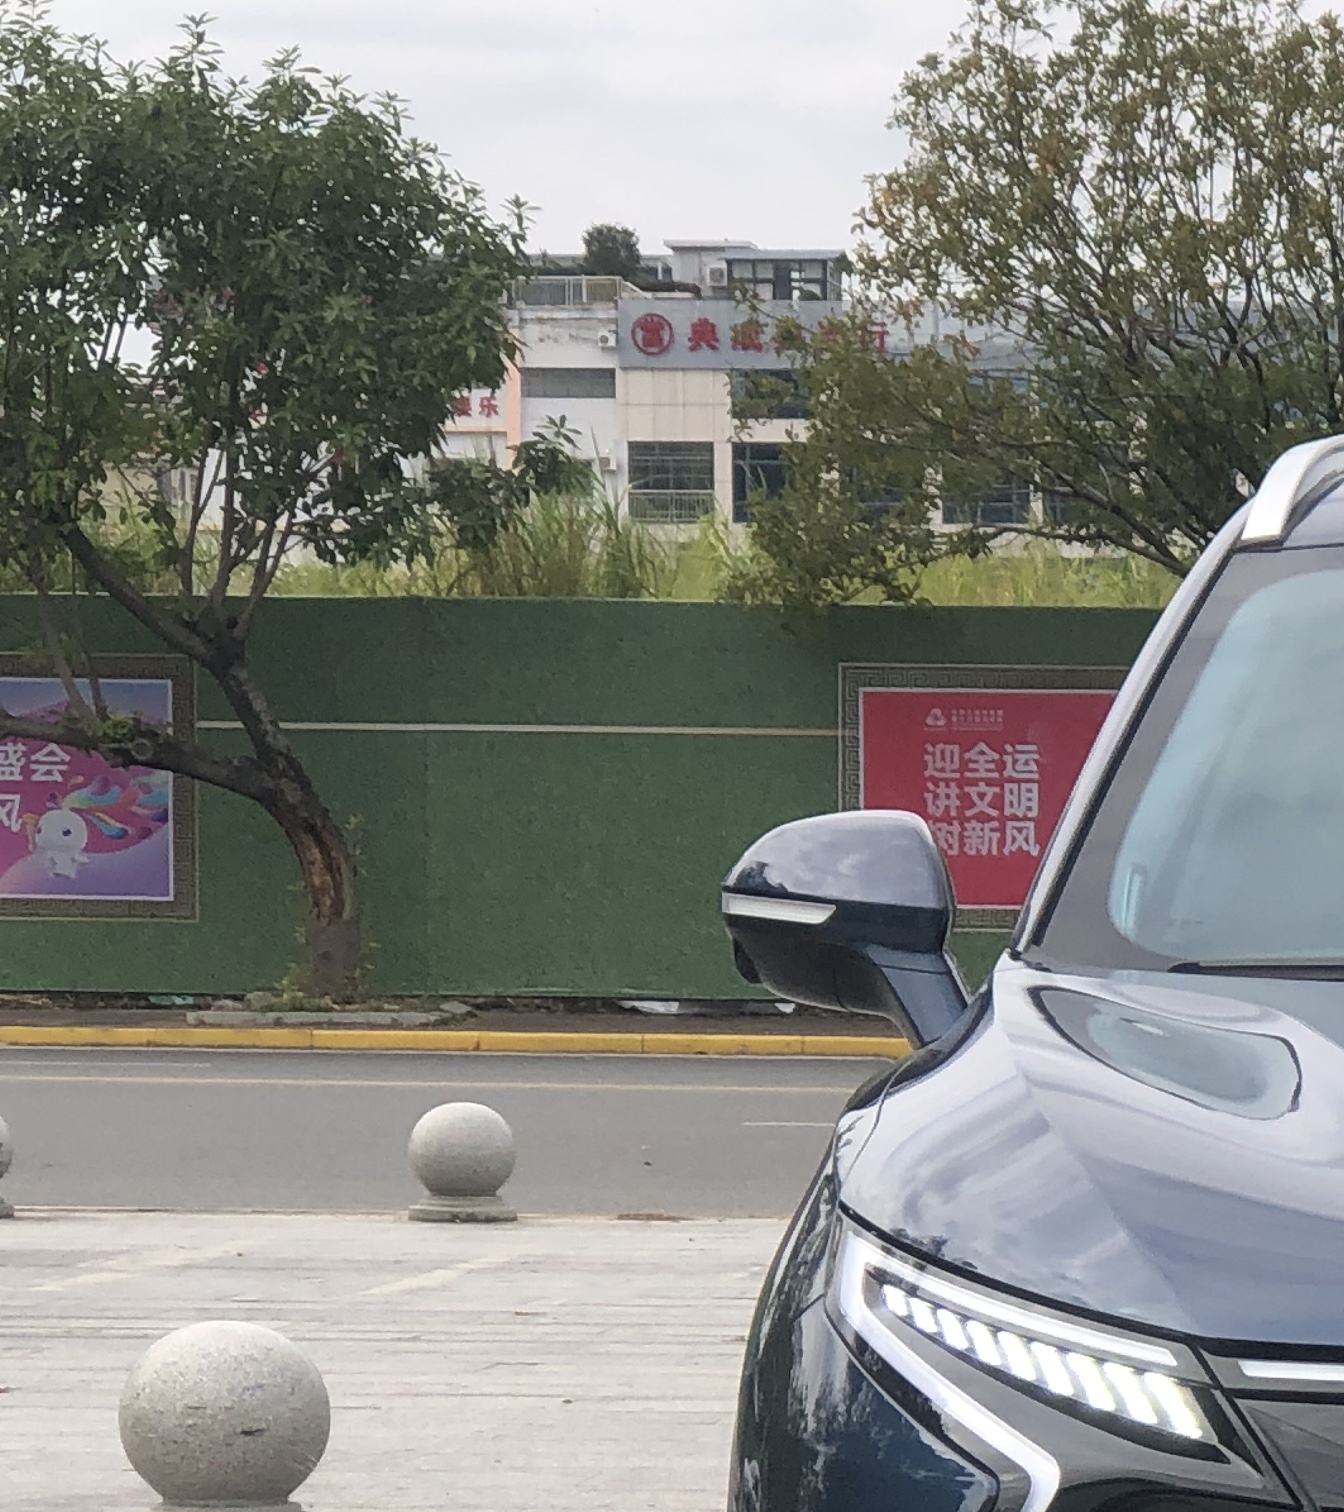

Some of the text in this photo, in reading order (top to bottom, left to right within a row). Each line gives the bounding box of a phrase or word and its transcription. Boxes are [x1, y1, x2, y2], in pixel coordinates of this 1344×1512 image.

[924, 742, 1040, 779] 迎全运
[924, 781, 1039, 818] 讲文明
